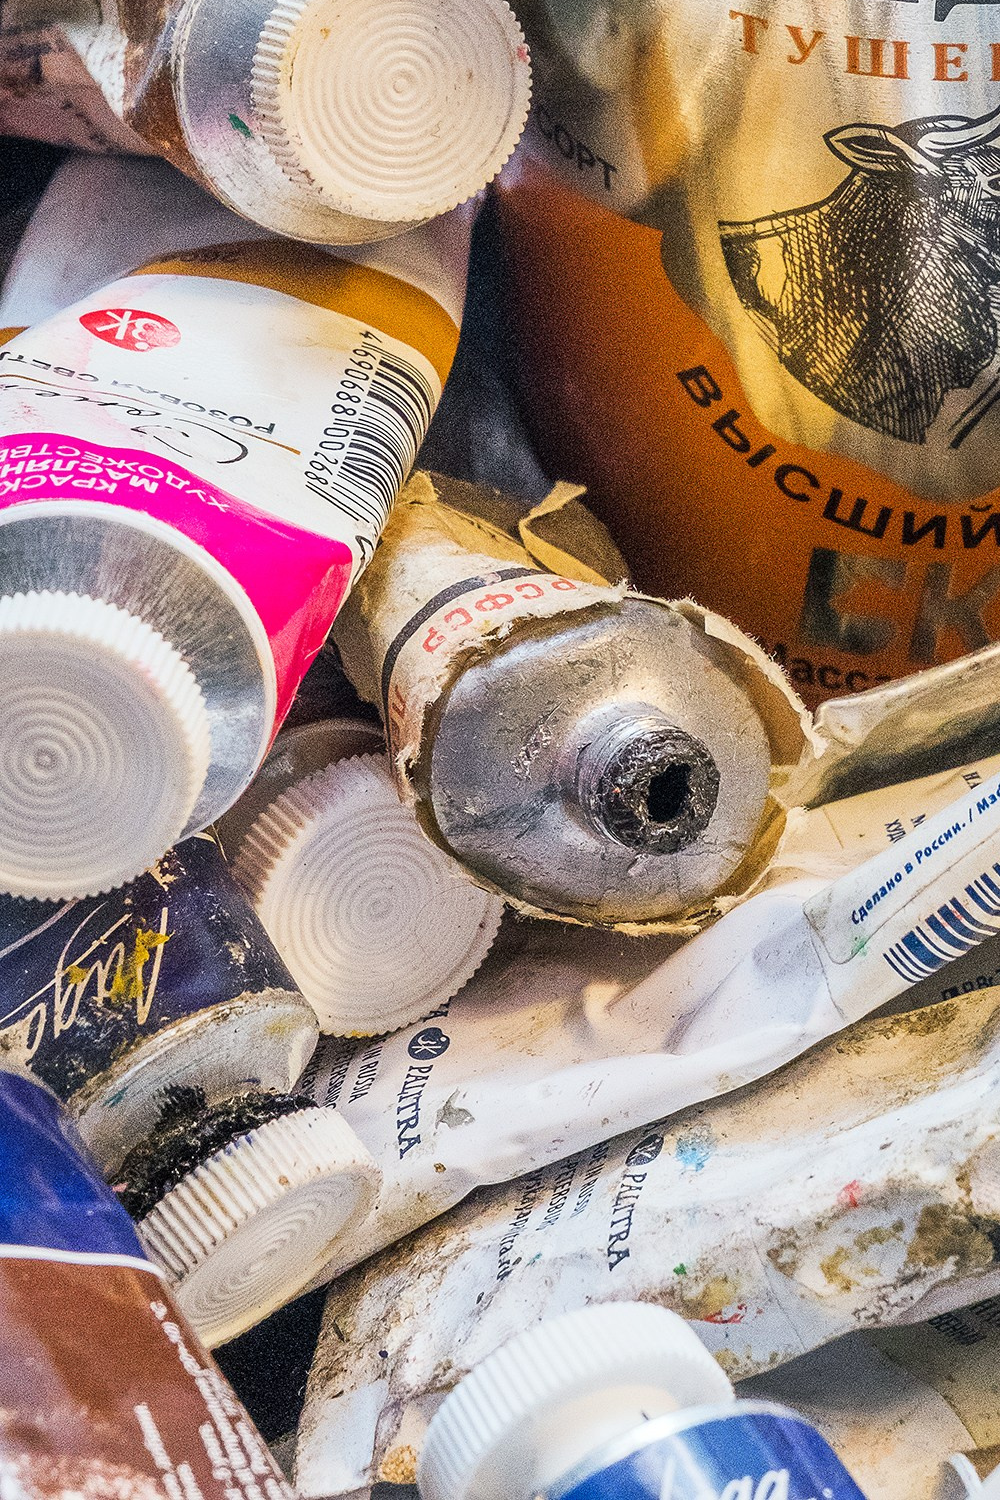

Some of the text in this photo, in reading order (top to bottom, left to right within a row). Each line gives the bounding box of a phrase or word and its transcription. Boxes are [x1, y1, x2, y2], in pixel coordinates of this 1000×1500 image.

[110, 379, 277, 435] РОЗОВАЯ
[774, 642, 897, 692] асс
[851, 871, 903, 925] Сделано
[903, 859, 915, 875] в
[913, 821, 967, 865] России.
[347, 1059, 381, 1104] RUSSIA
[396, 1064, 435, 1161] PALITRA
[609, 1171, 647, 1272] PALITRA
